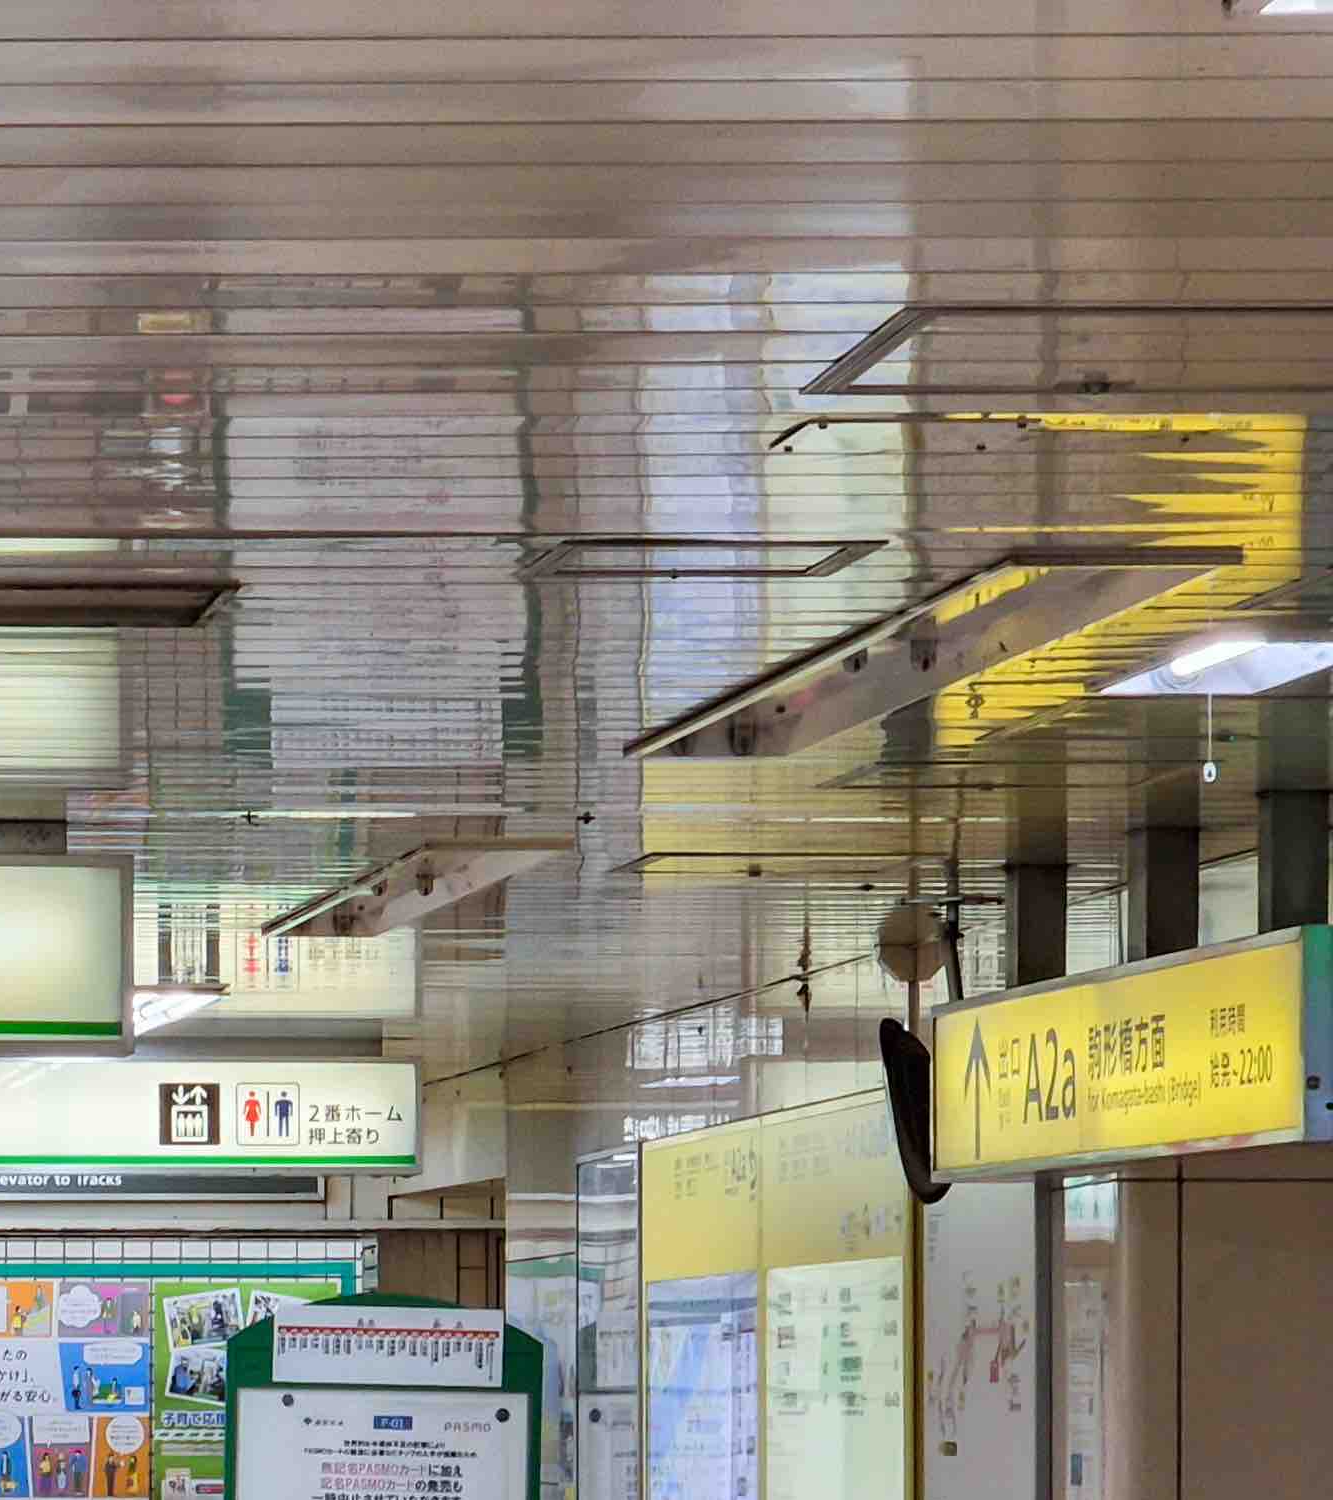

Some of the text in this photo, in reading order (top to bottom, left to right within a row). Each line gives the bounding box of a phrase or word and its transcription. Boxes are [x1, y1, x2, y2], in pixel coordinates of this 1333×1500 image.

[1087, 1013, 1166, 1081] 駒形橋方面
[1022, 1026, 1077, 1125] A2a
[308, 1127, 381, 1146] 押上寄り
[444, 1421, 492, 1433] PASMO
